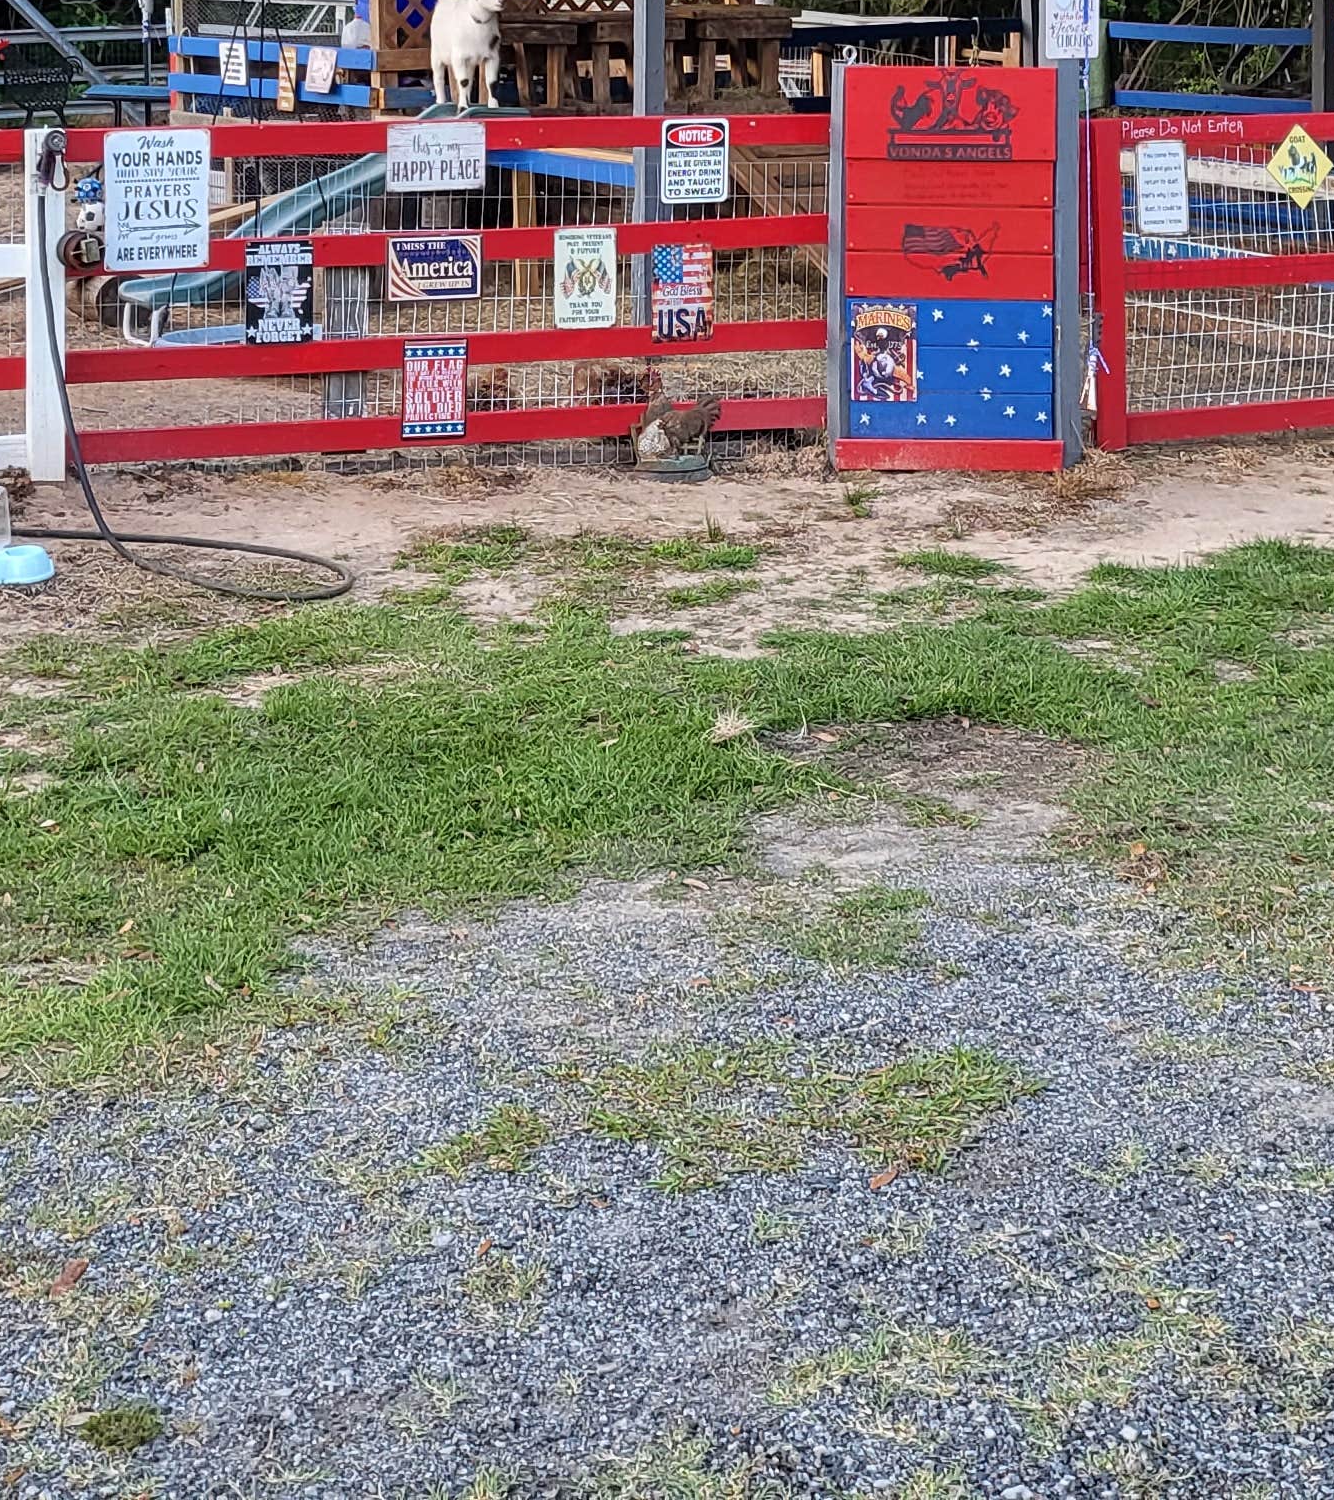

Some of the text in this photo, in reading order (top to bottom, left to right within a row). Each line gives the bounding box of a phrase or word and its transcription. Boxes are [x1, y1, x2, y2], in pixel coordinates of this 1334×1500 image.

[1122, 121, 1156, 140] Please
[1160, 119, 1178, 137] Do
[1182, 119, 1201, 135] Not
[138, 135, 174, 150] Wash
[678, 130, 714, 143] NOTICE
[113, 150, 203, 168] YOUR HANDS
[957, 147, 1011, 158] ANGELS
[392, 159, 480, 182] HAPPY PLACE
[668, 170, 696, 178] ENERGY
[668, 178, 722, 187] AND TAUGHT
[125, 184, 191, 198] PRAYERS
[685, 188, 721, 196] SWEAR
[117, 199, 199, 221] JESUS
[117, 244, 198, 262] ARE EVERYWHERE
[259, 244, 301, 254] ALWAYS
[396, 242, 447, 251] I MISS THE
[246, 253, 313, 266] REMEMBER
[399, 256, 474, 278] America
[258, 318, 301, 331] NEVER
[658, 307, 708, 342] USA
[858, 312, 911, 330] MARINES
[256, 330, 302, 343] FORGET
[407, 360, 464, 372] OUR FLAG
[406, 391, 462, 404] SOLDIER
[406, 402, 462, 414] WHO DIED
